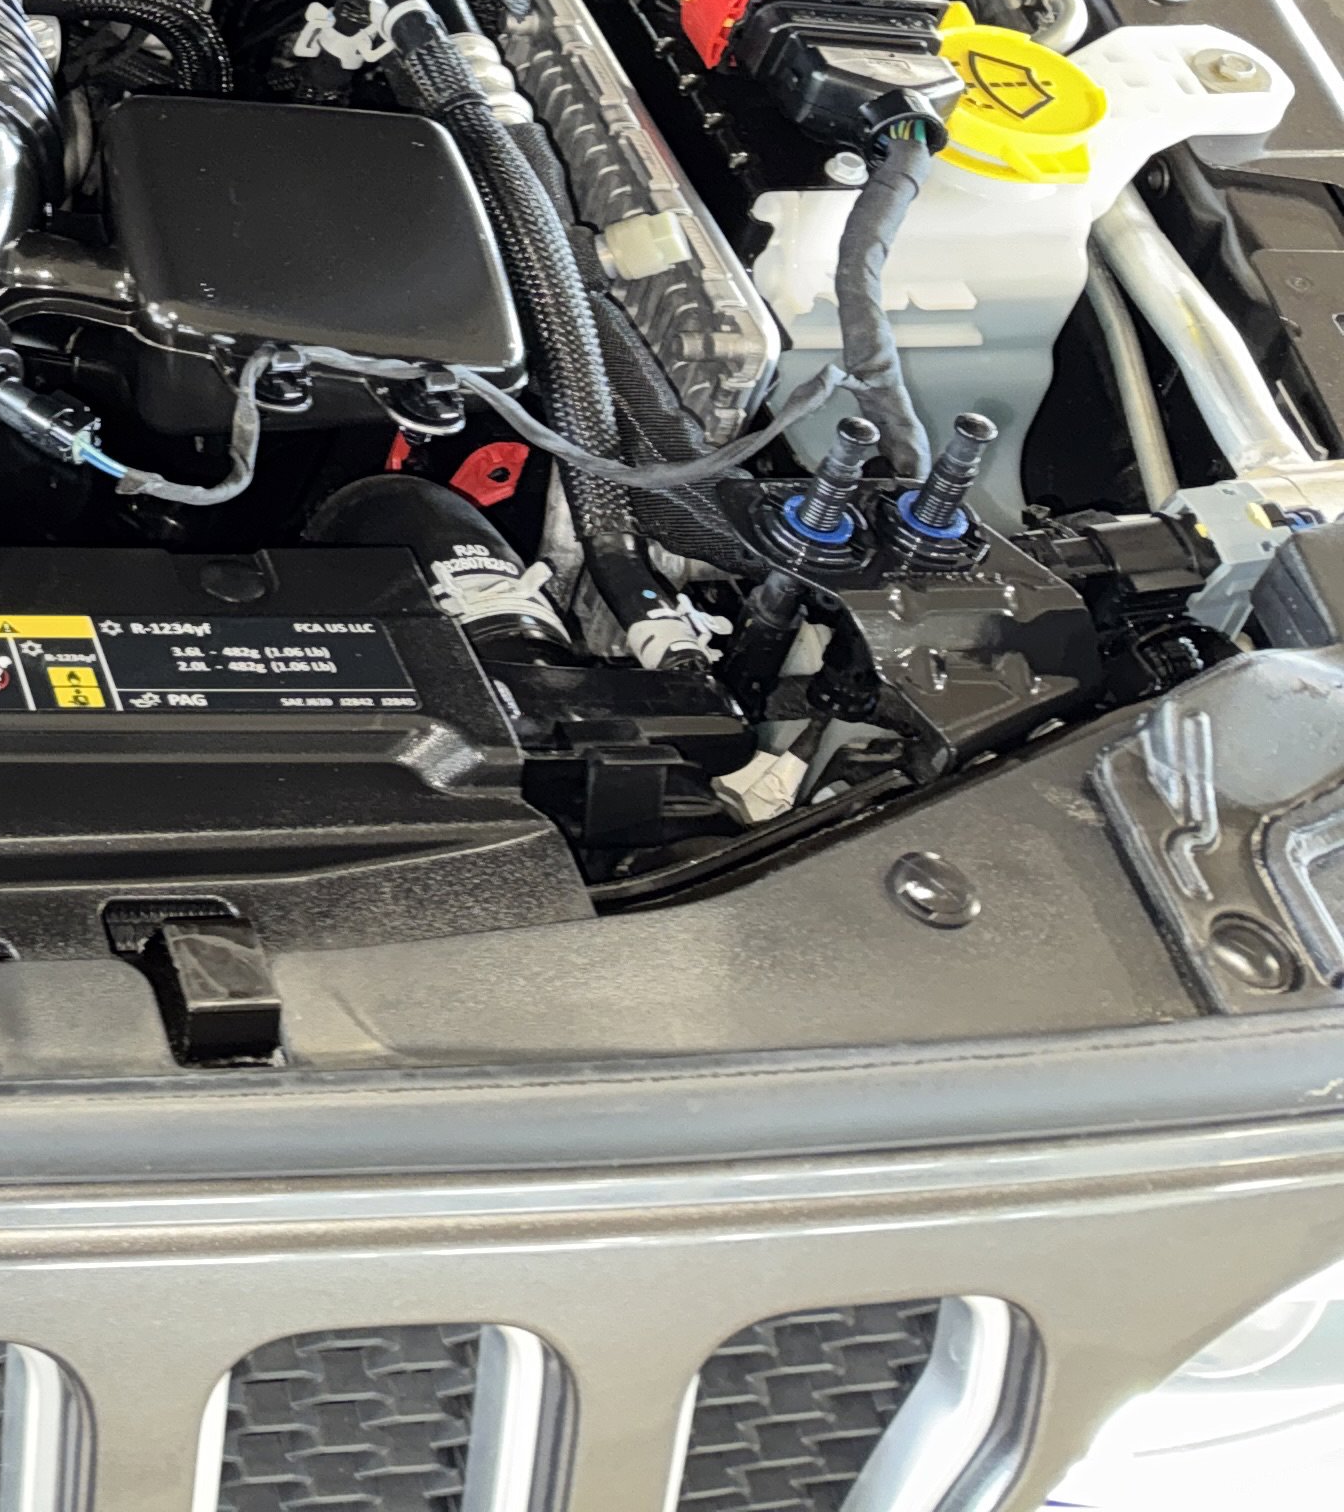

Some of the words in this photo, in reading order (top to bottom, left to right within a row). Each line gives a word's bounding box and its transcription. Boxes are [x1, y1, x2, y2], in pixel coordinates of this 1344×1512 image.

[452, 544, 490, 557] RAD
[130, 622, 212, 637] R-1234yf
[293, 623, 324, 633] FCA
[324, 623, 349, 633] US
[348, 623, 376, 633] LLC
[170, 646, 205, 657] 3.6L
[176, 661, 211, 672] 2.0L
[167, 693, 209, 707] PAG
